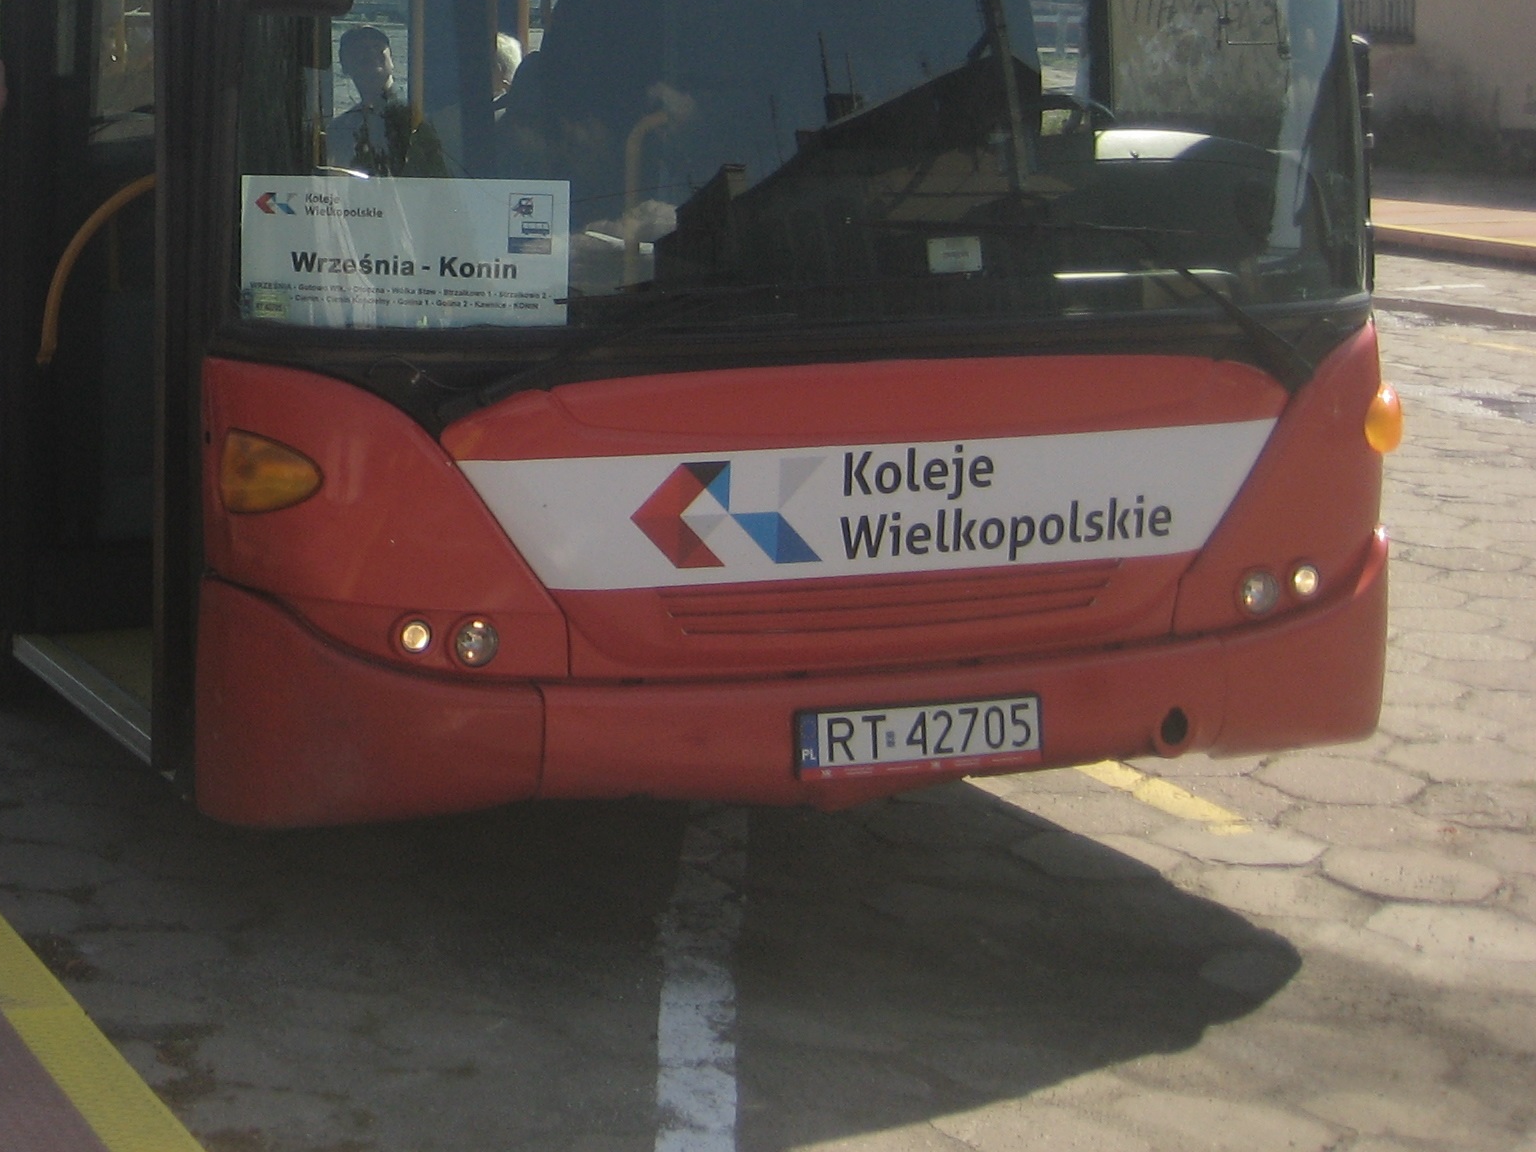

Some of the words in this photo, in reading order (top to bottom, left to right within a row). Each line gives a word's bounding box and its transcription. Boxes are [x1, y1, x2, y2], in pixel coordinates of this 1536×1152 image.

[305, 193, 340, 205] Koleje
[305, 205, 383, 218] Wielkopolskie
[291, 251, 414, 276] Września
[439, 256, 517, 279] Konin
[842, 444, 995, 500] Koleje
[840, 496, 1172, 561] Wielkopolskie
[827, 714, 886, 763] RT
[906, 703, 1032, 756] 42705
[801, 749, 817, 761] PL
